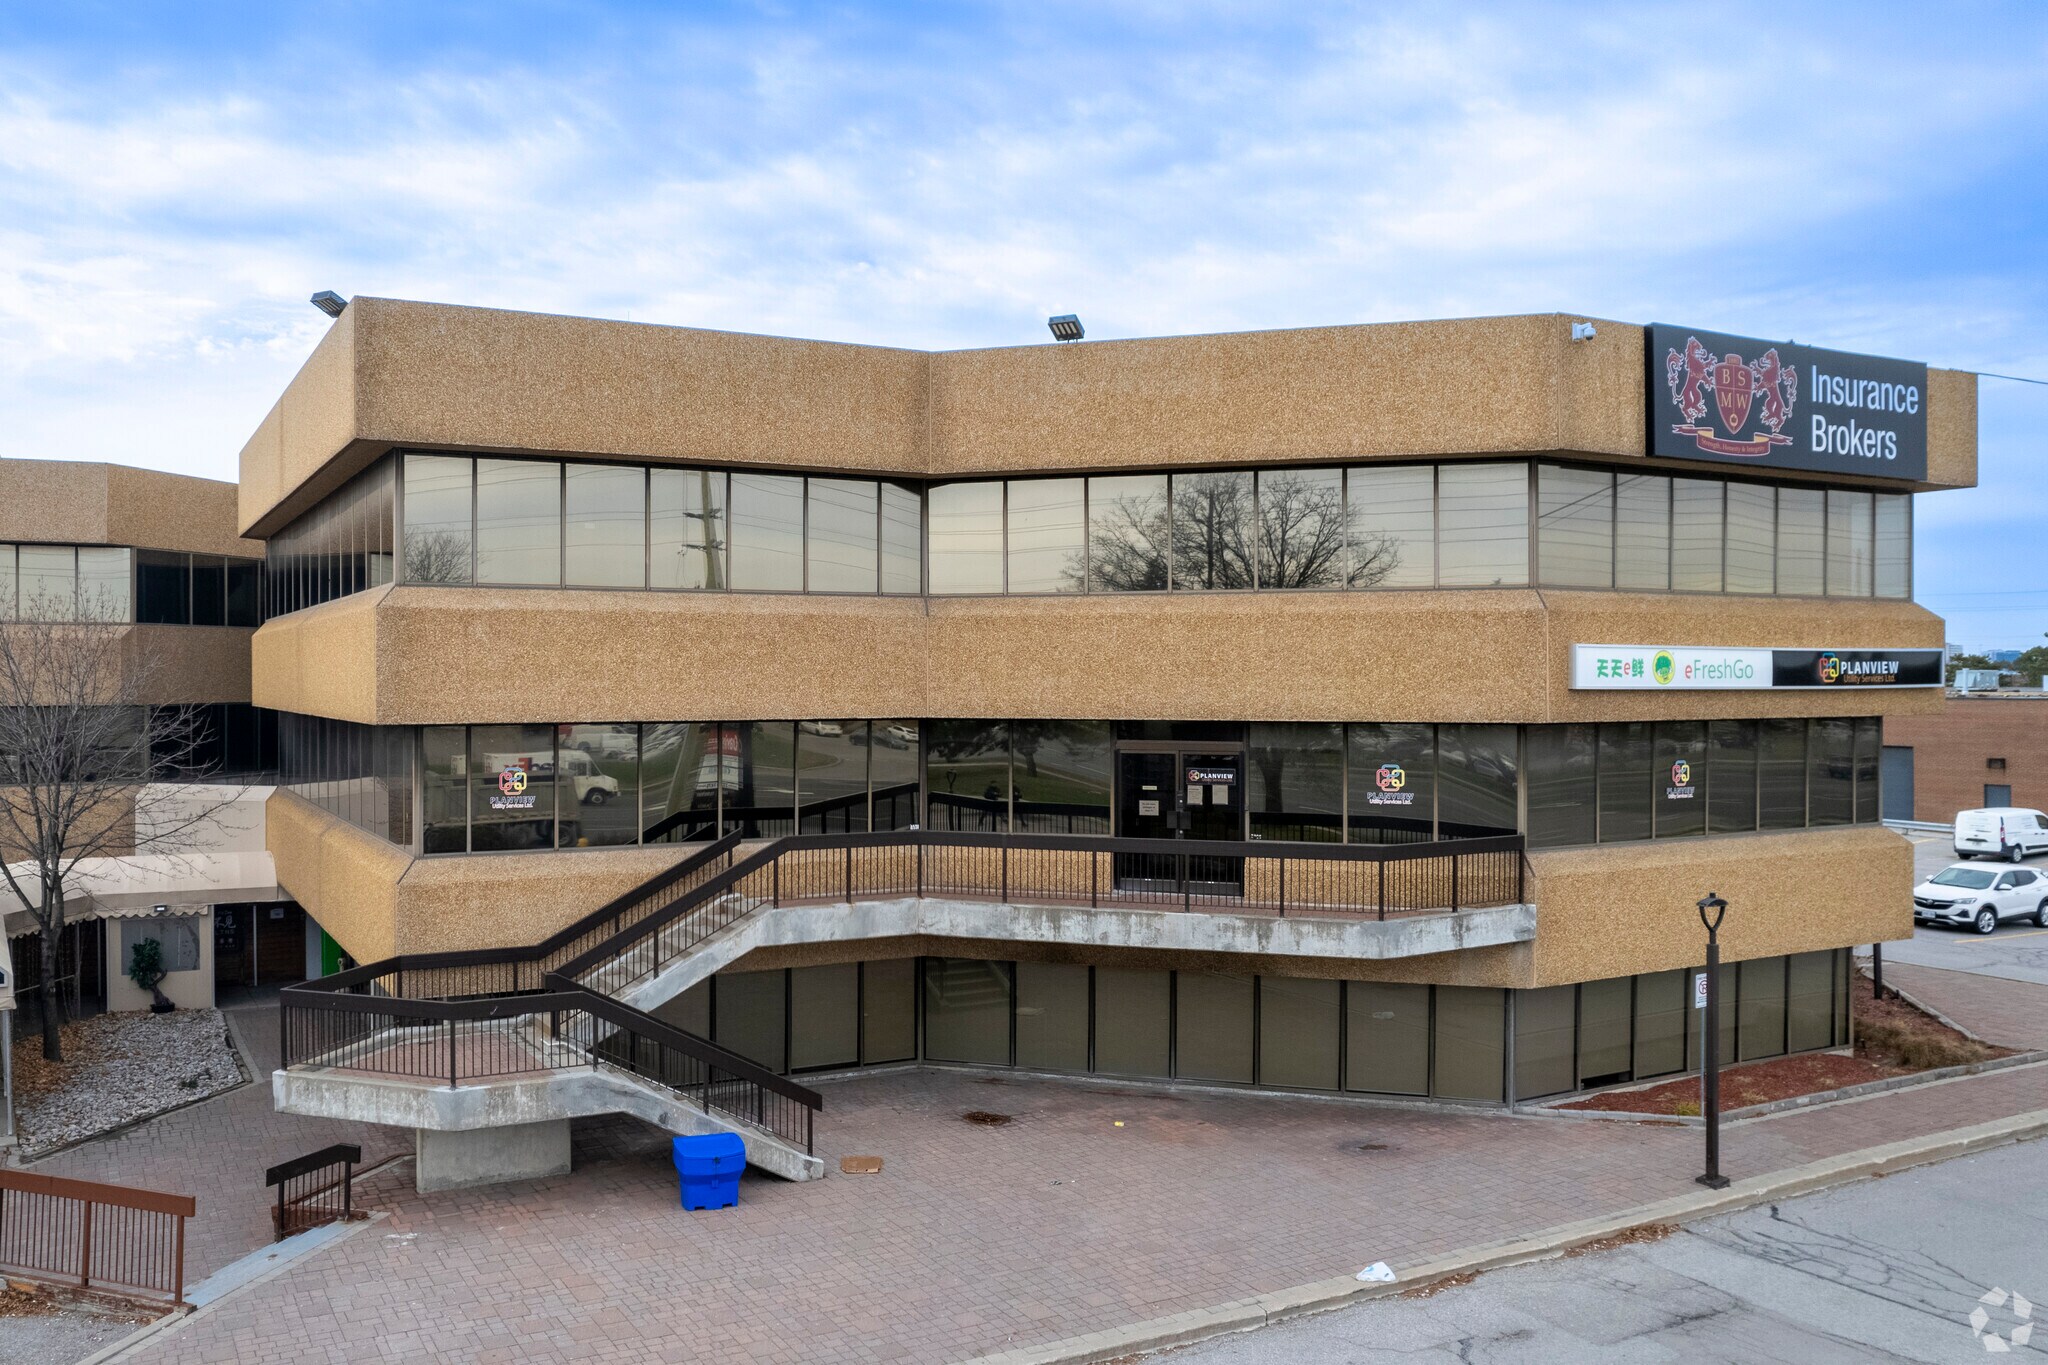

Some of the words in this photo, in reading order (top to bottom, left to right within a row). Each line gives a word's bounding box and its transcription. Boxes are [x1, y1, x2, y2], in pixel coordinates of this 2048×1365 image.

[1722, 367, 1731, 385] B
[1737, 370, 1746, 387] S
[1811, 365, 1919, 415] Insurance
[1720, 392, 1732, 409] M
[1736, 394, 1749, 411] W
[1811, 414, 1898, 461] Brokers
[1685, 659, 1754, 679] eFreshGo
[1840, 661, 1899, 675] PLANVIEW
[1843, 674, 1861, 684] Utility
[1861, 674, 1884, 683] Services
[1885, 674, 1896, 683] Ltd.
[490, 796, 536, 804] PLANVIEW
[1367, 792, 1414, 800] PLANVIEW
